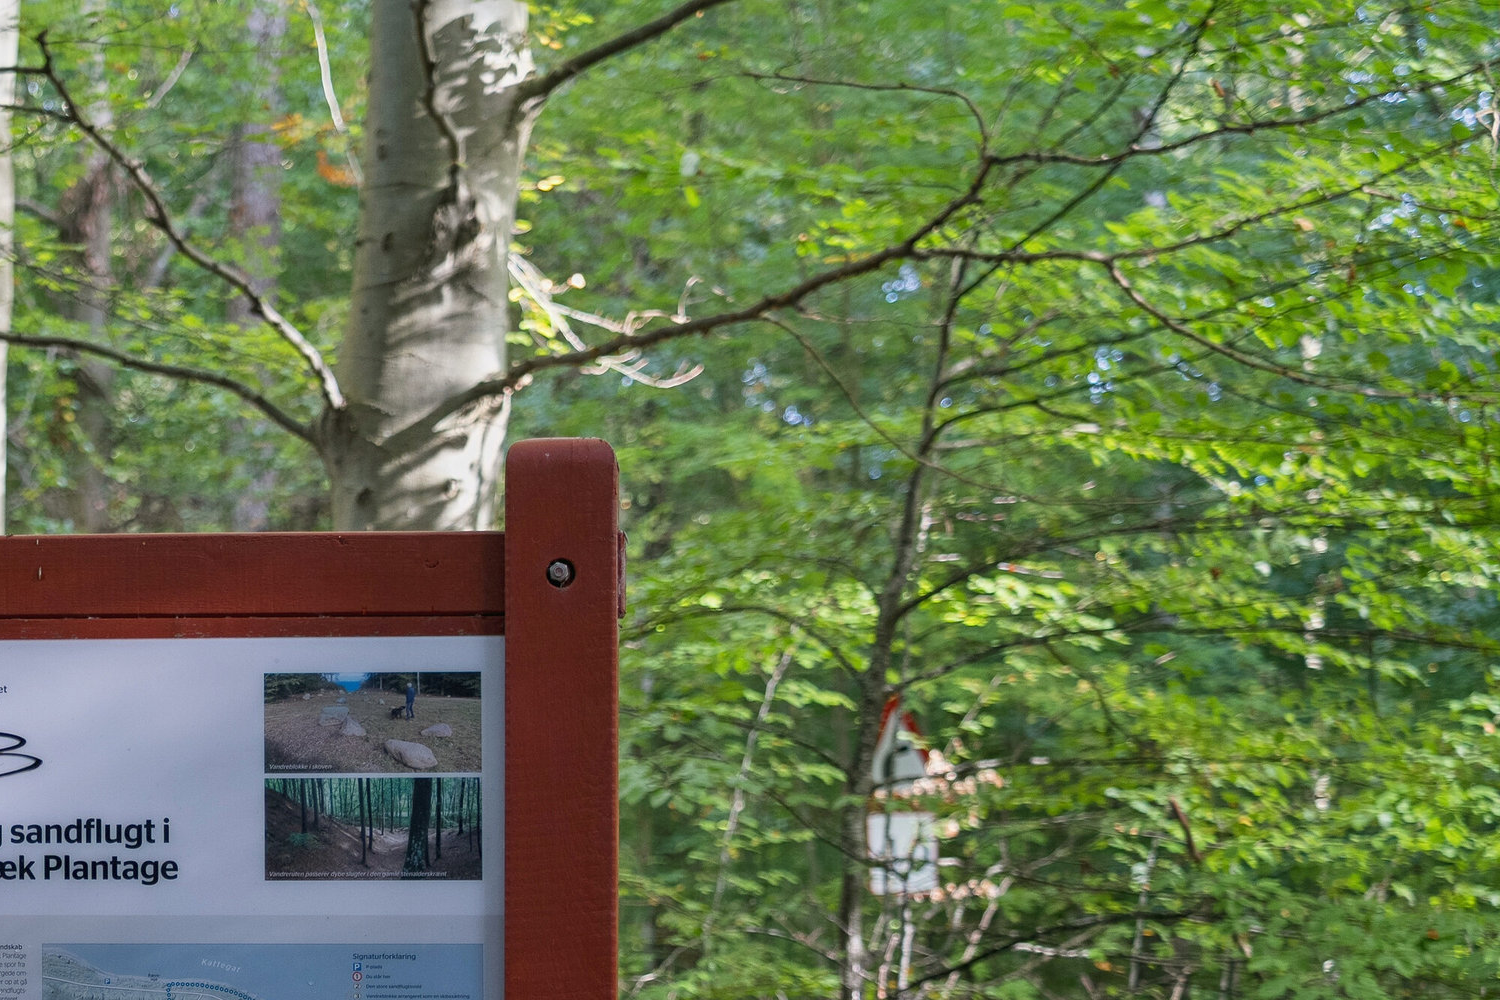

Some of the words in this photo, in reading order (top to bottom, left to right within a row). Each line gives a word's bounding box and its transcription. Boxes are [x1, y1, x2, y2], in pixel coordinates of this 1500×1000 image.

[10, 818, 156, 850] sandflugt
[162, 818, 170, 844] i
[44, 854, 178, 885] Plantage
[202, 959, 241, 973] Kattegat
